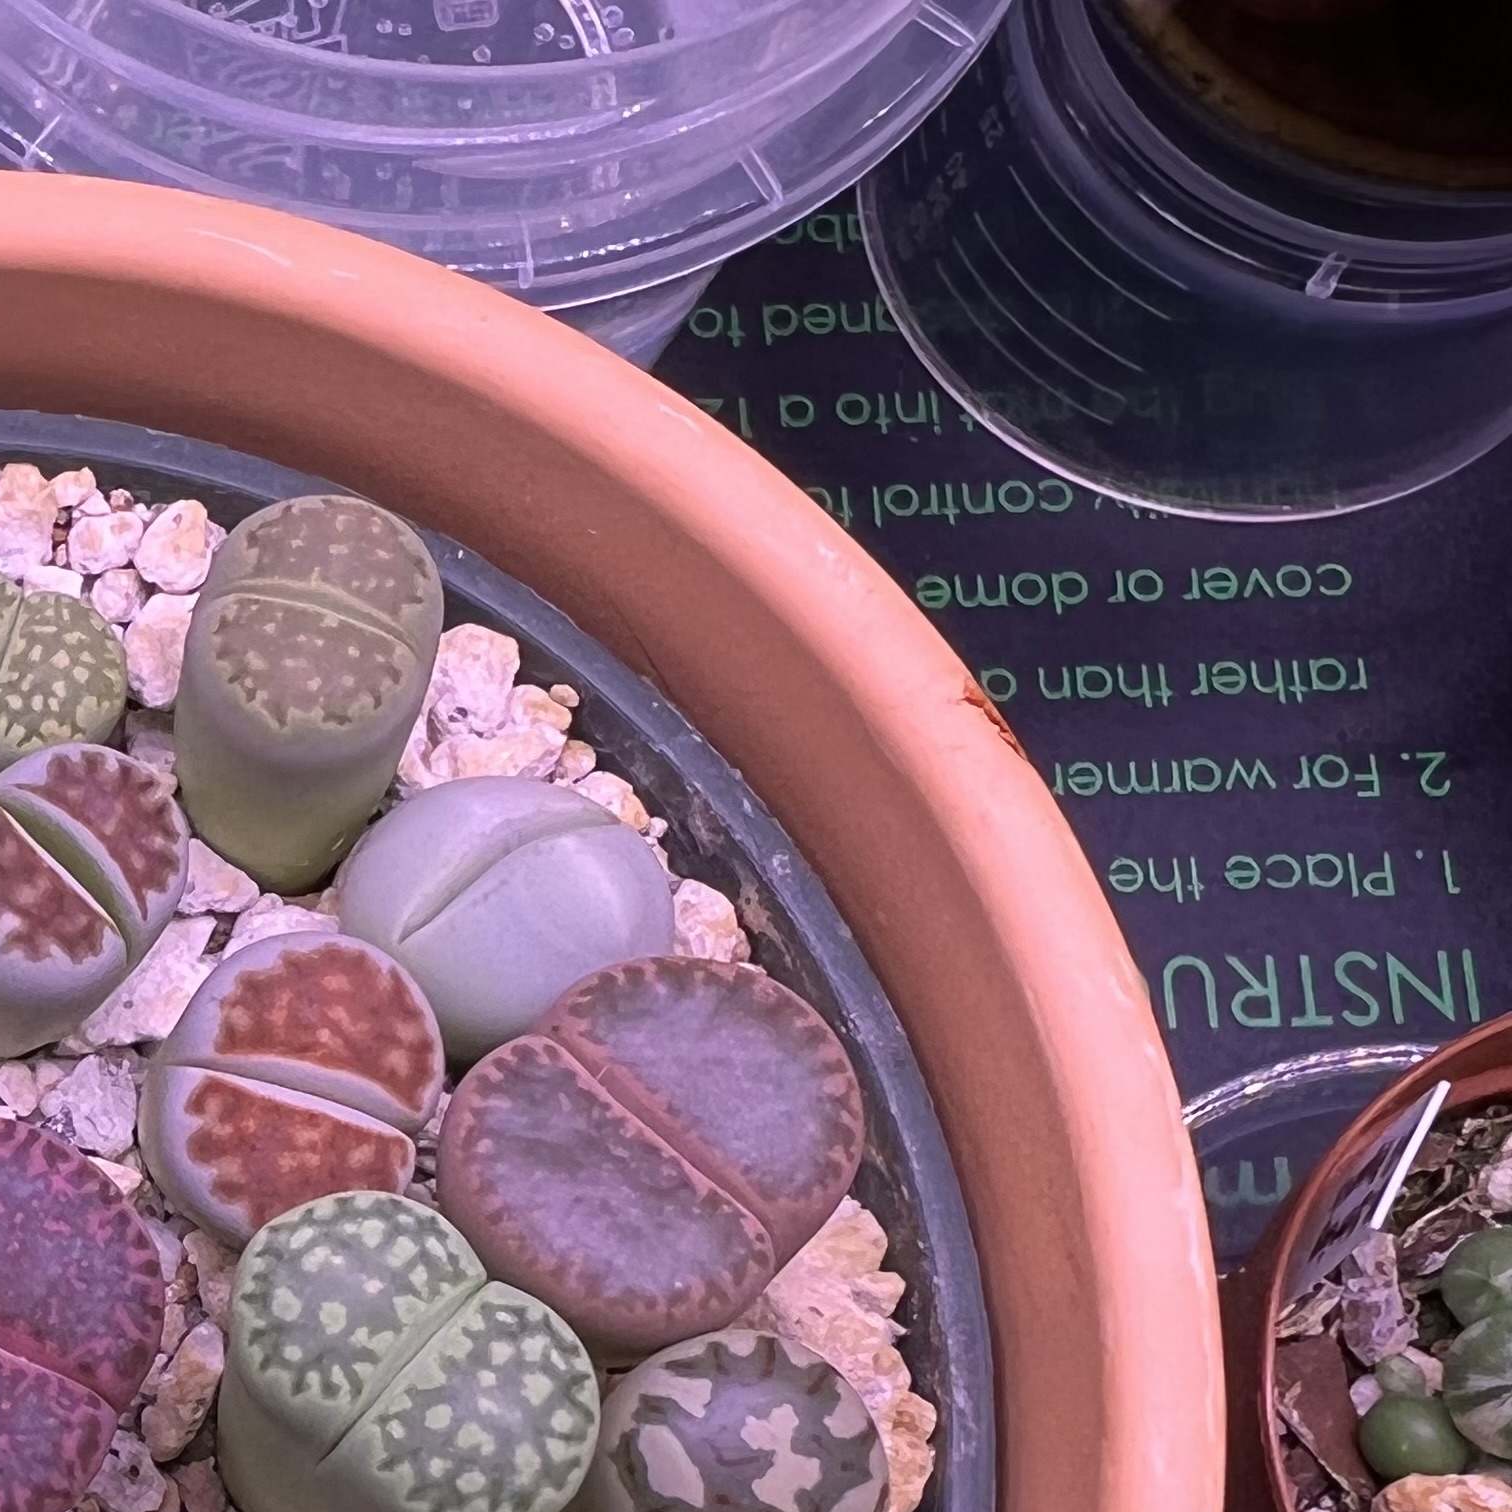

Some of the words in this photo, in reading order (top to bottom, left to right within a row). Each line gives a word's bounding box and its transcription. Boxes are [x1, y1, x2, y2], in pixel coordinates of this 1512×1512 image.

[689, 304, 745, 348] to
[779, 394, 814, 429] a
[835, 390, 942, 436] into
[872, 478, 1073, 529] control
[916, 570, 1088, 614] dome
[1109, 569, 1164, 607] or
[1186, 560, 1352, 603] cover
[1038, 662, 1174, 709] than
[1192, 655, 1368, 706] rather
[1292, 753, 1379, 797] For
[1400, 750, 1450, 795] 2.
[1108, 855, 1205, 903] the
[1224, 851, 1394, 900] Place
[1413, 847, 1462, 895] 1.
[1162, 948, 1481, 1031] INSTRU
